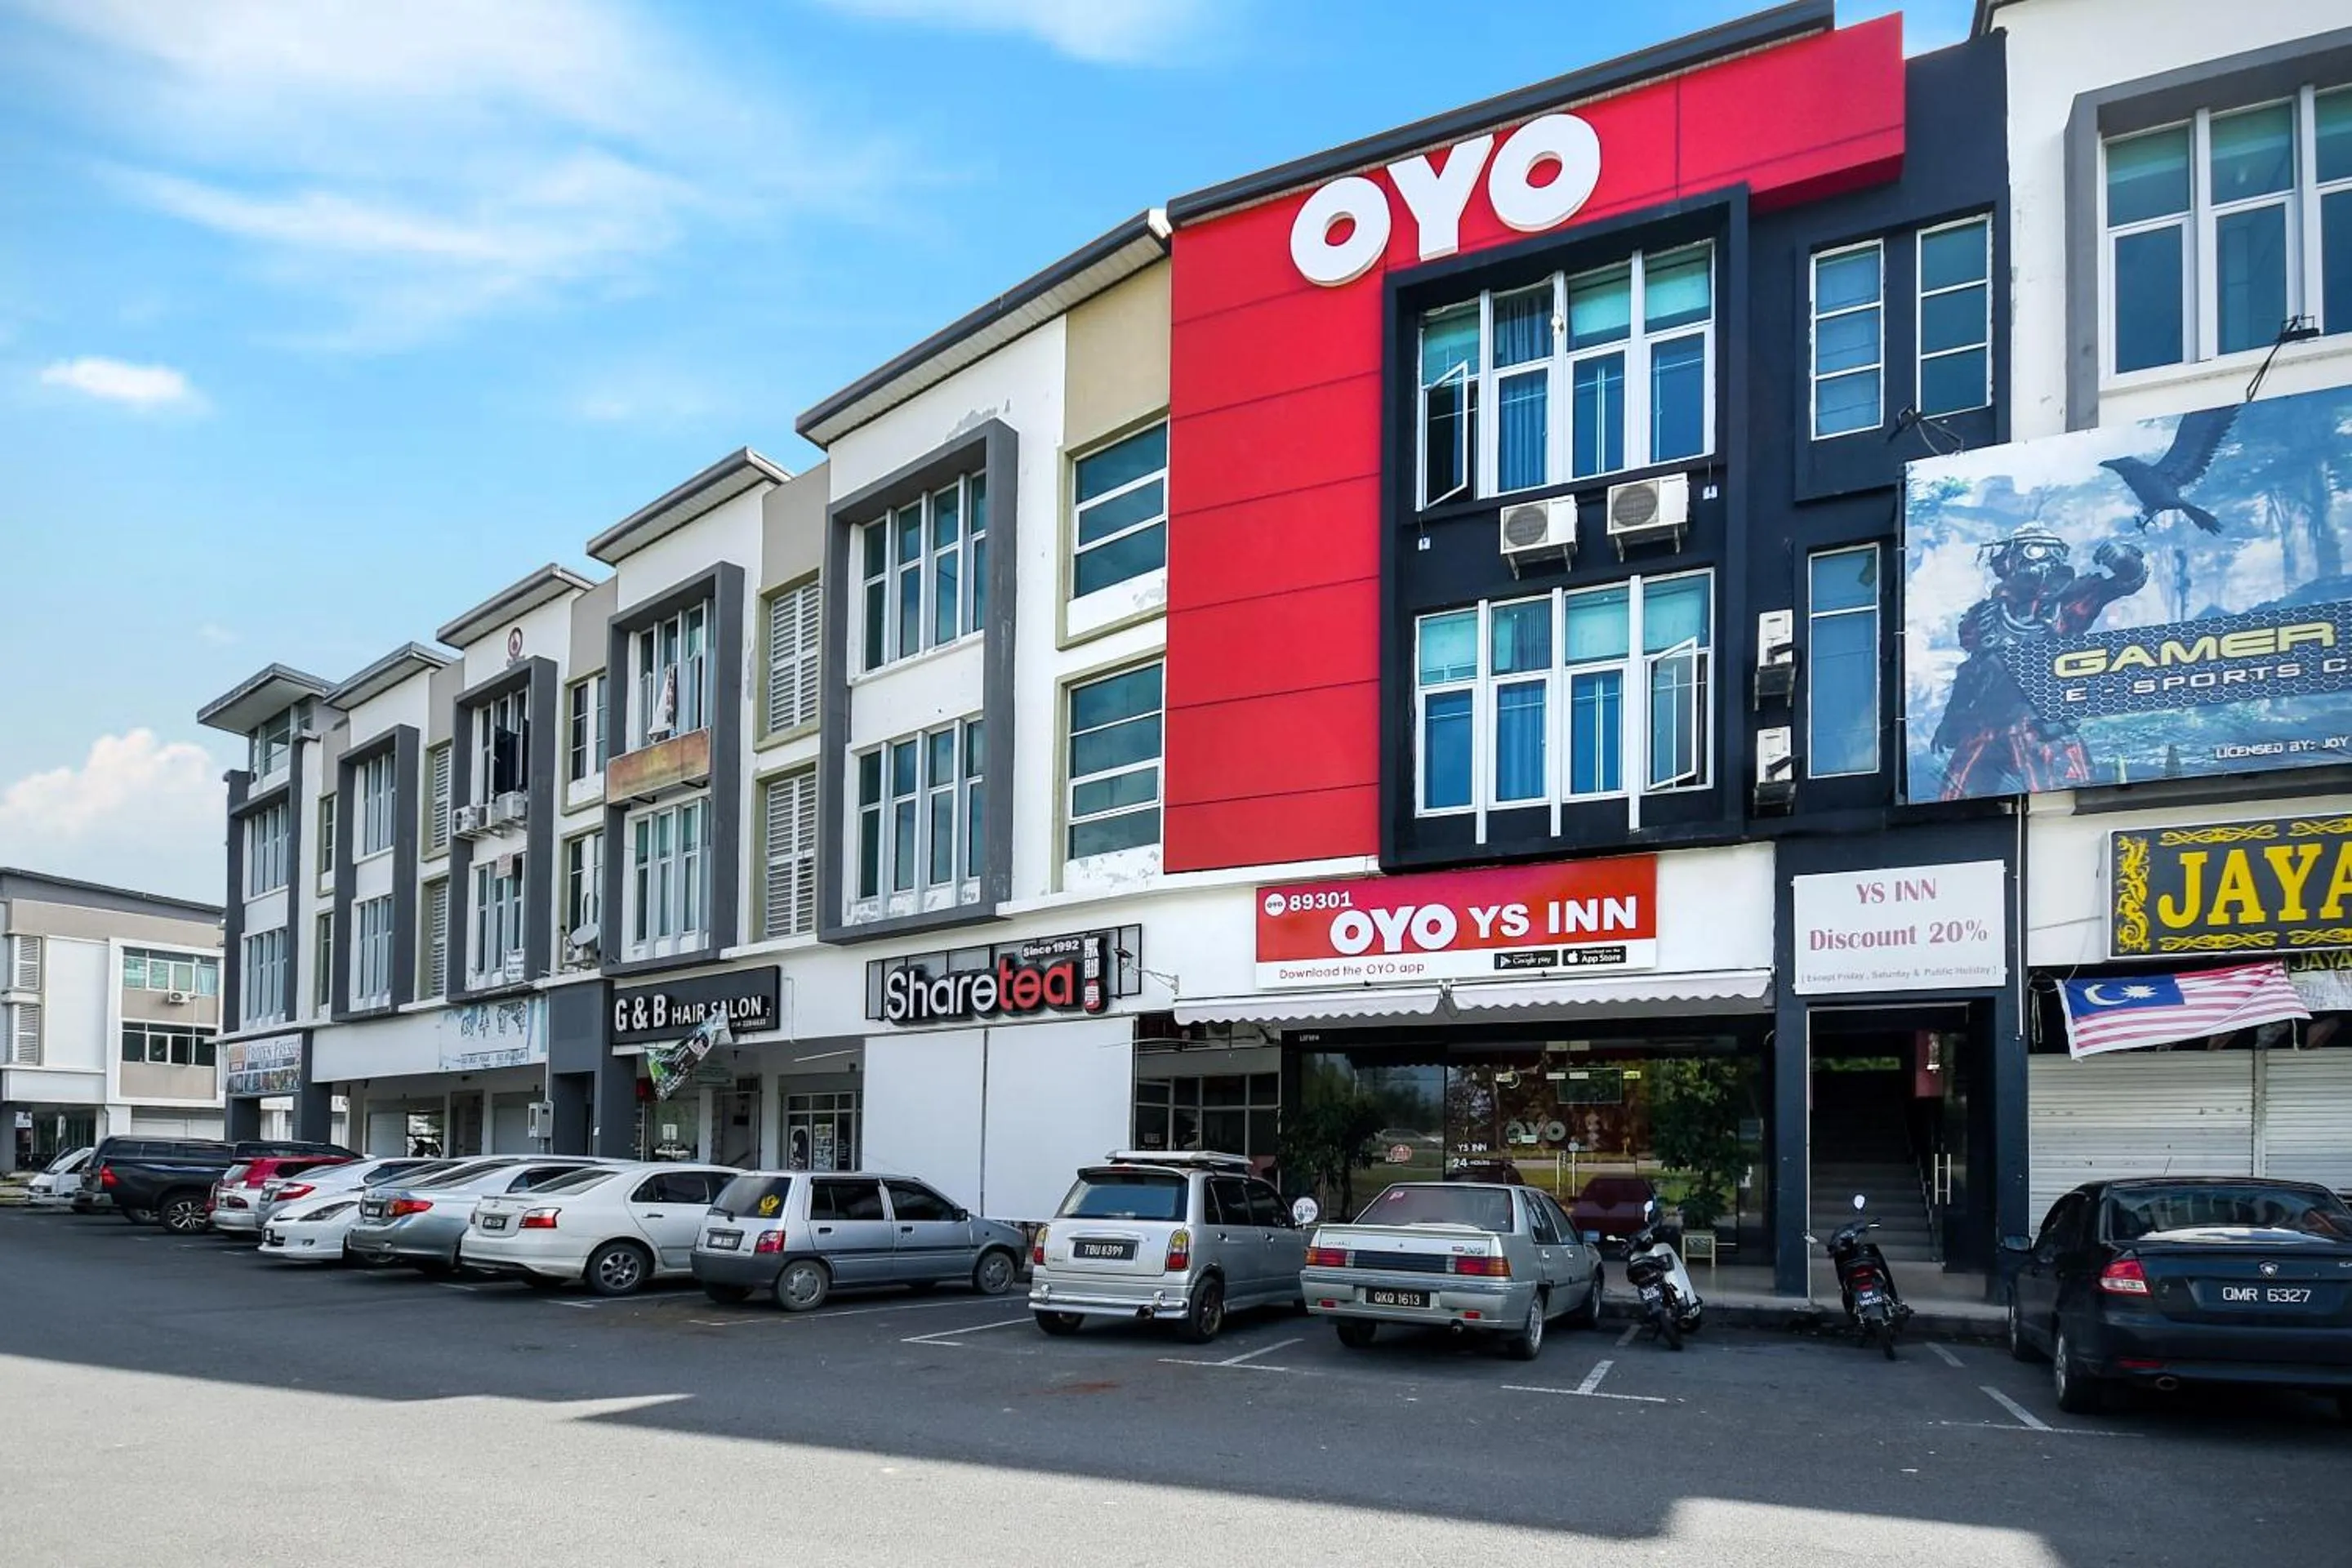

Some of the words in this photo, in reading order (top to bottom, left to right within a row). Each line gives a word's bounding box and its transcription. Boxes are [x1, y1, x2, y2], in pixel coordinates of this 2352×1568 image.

[1289, 113, 1601, 287] OYO
[2053, 621, 2336, 679] GAMER
[2132, 662, 2301, 695] SPORTS
[2322, 736, 2350, 750] JOY
[1288, 890, 1354, 911] 89301
[1855, 881, 1886, 905] YS
[1895, 877, 1936, 902] INN
[1330, 903, 1459, 955] OYO
[1468, 902, 1530, 939] YS
[1548, 895, 1637, 934] INN
[1809, 924, 1917, 951] Discount
[1928, 919, 1988, 944] 20%
[1022, 944, 1051, 958] Since
[1053, 939, 1080, 953] 1992
[1279, 965, 1339, 979] Download
[1343, 964, 1362, 975] the
[1366, 962, 1396, 975] OYO
[1400, 963, 1424, 974] app
[885, 956, 1074, 1021] Sharetea
[671, 1003, 706, 1027] HAIR
[2222, 1286, 2259, 1302] QMR
[2267, 1287, 2311, 1303] 6327
